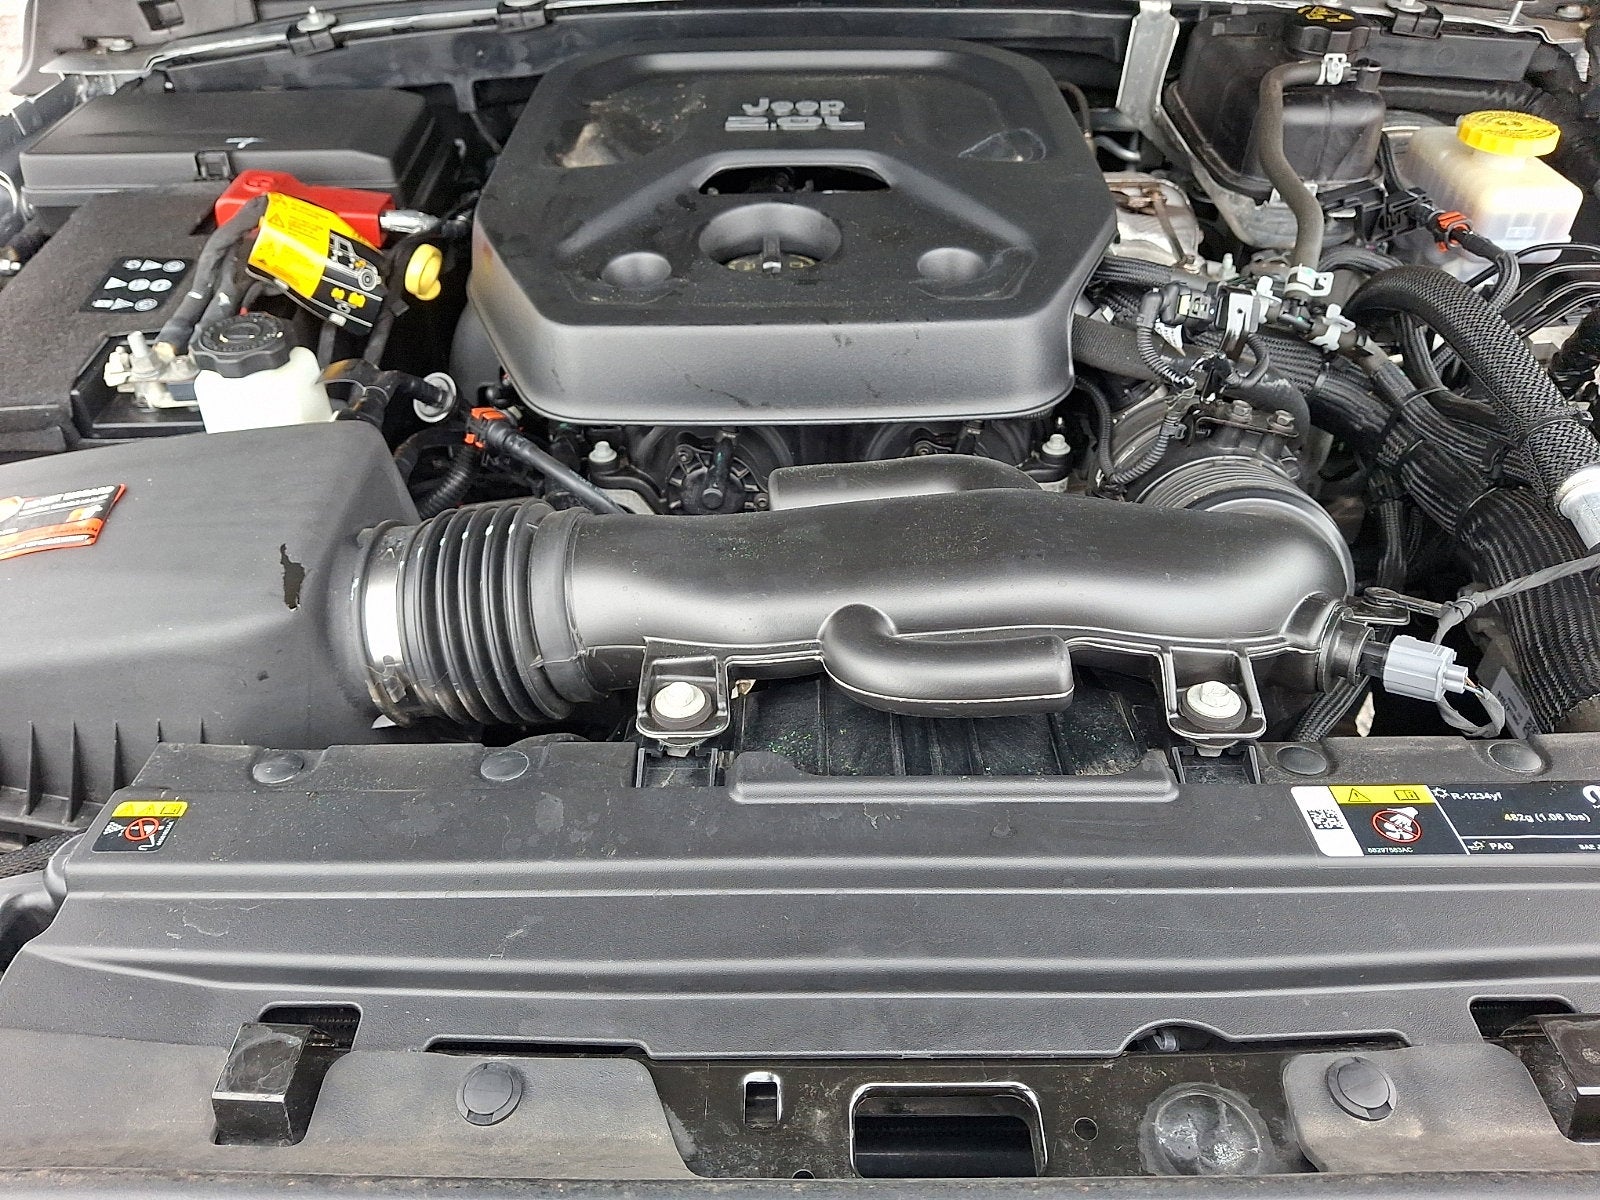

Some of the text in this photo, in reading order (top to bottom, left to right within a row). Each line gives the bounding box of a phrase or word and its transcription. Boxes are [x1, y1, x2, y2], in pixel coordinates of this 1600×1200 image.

[742, 97, 845, 116] Jeep
[725, 115, 866, 131] 2.0L
[1450, 792, 1502, 802] R-1234yf
[1489, 842, 1515, 850] PAG
